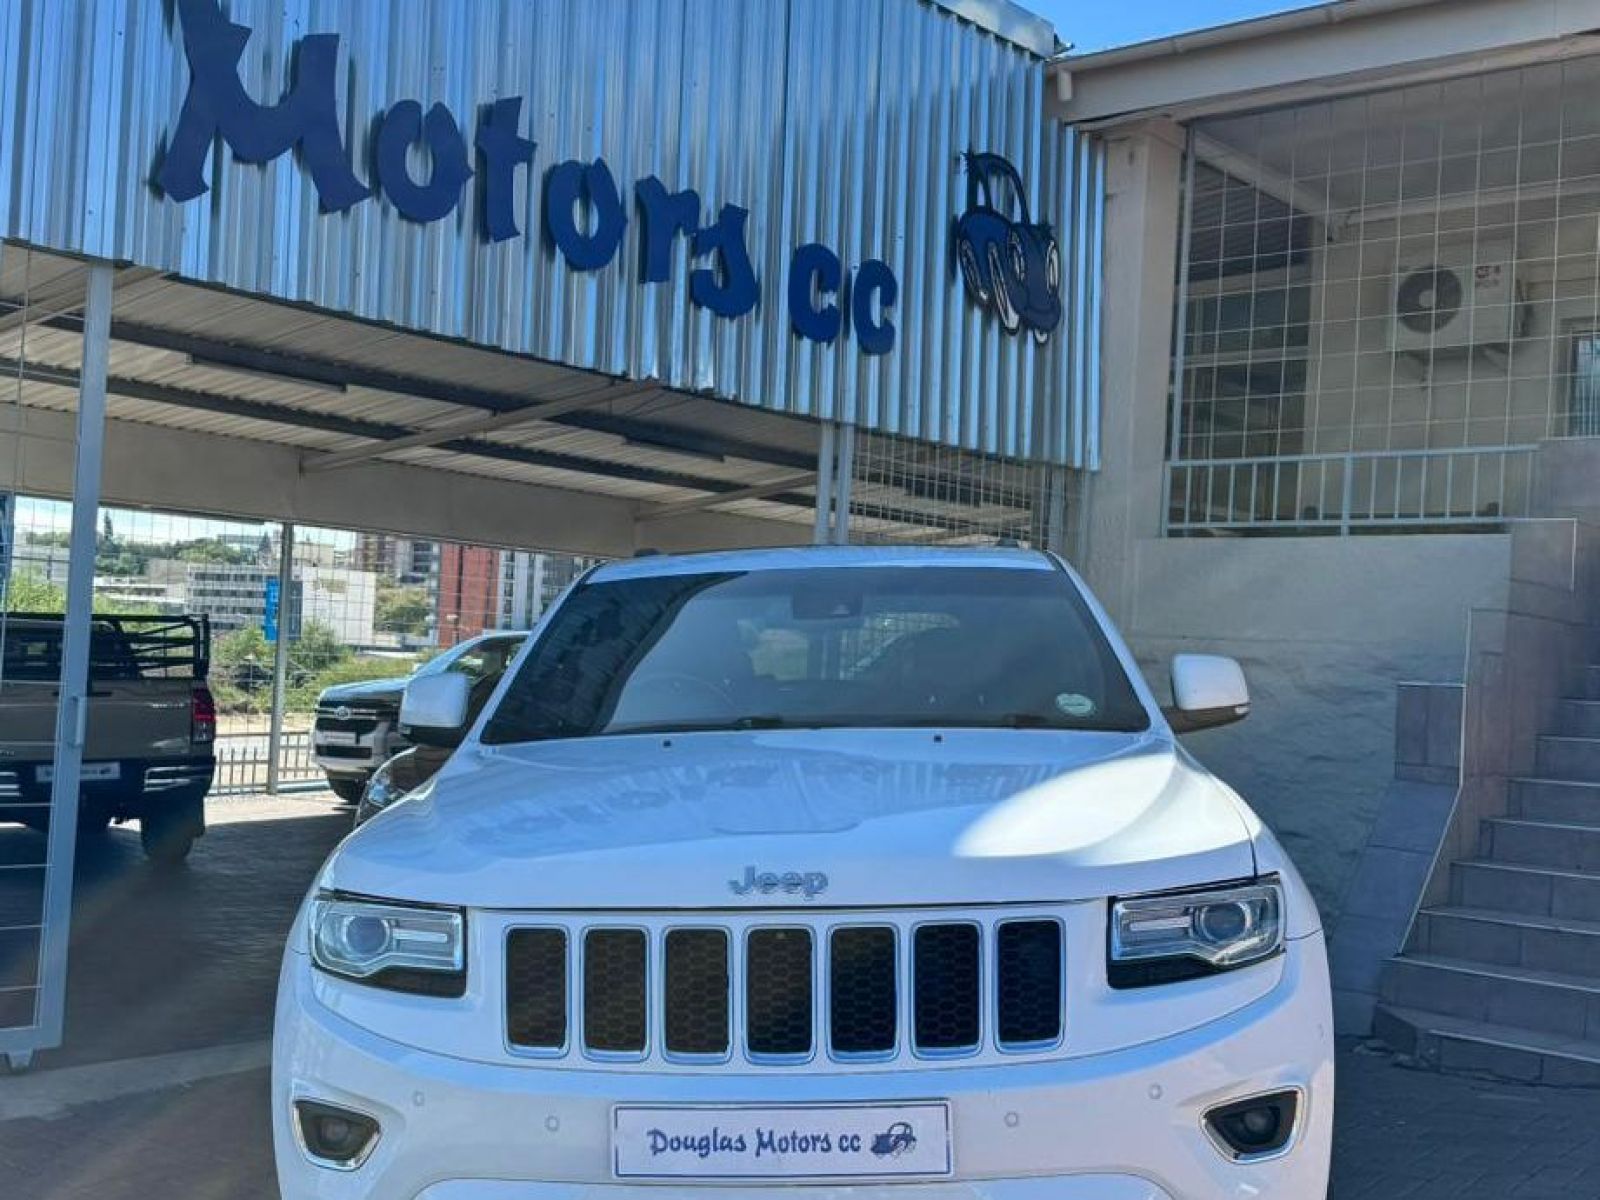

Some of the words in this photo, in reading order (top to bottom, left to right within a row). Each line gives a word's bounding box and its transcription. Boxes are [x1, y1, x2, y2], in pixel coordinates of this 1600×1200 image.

[160, 0, 760, 319] Motors
[793, 244, 898, 356] cc
[728, 866, 829, 901] Jeep
[647, 1127, 746, 1159] Douglas
[755, 1127, 832, 1158] Motors
[837, 1135, 862, 1153] cc
